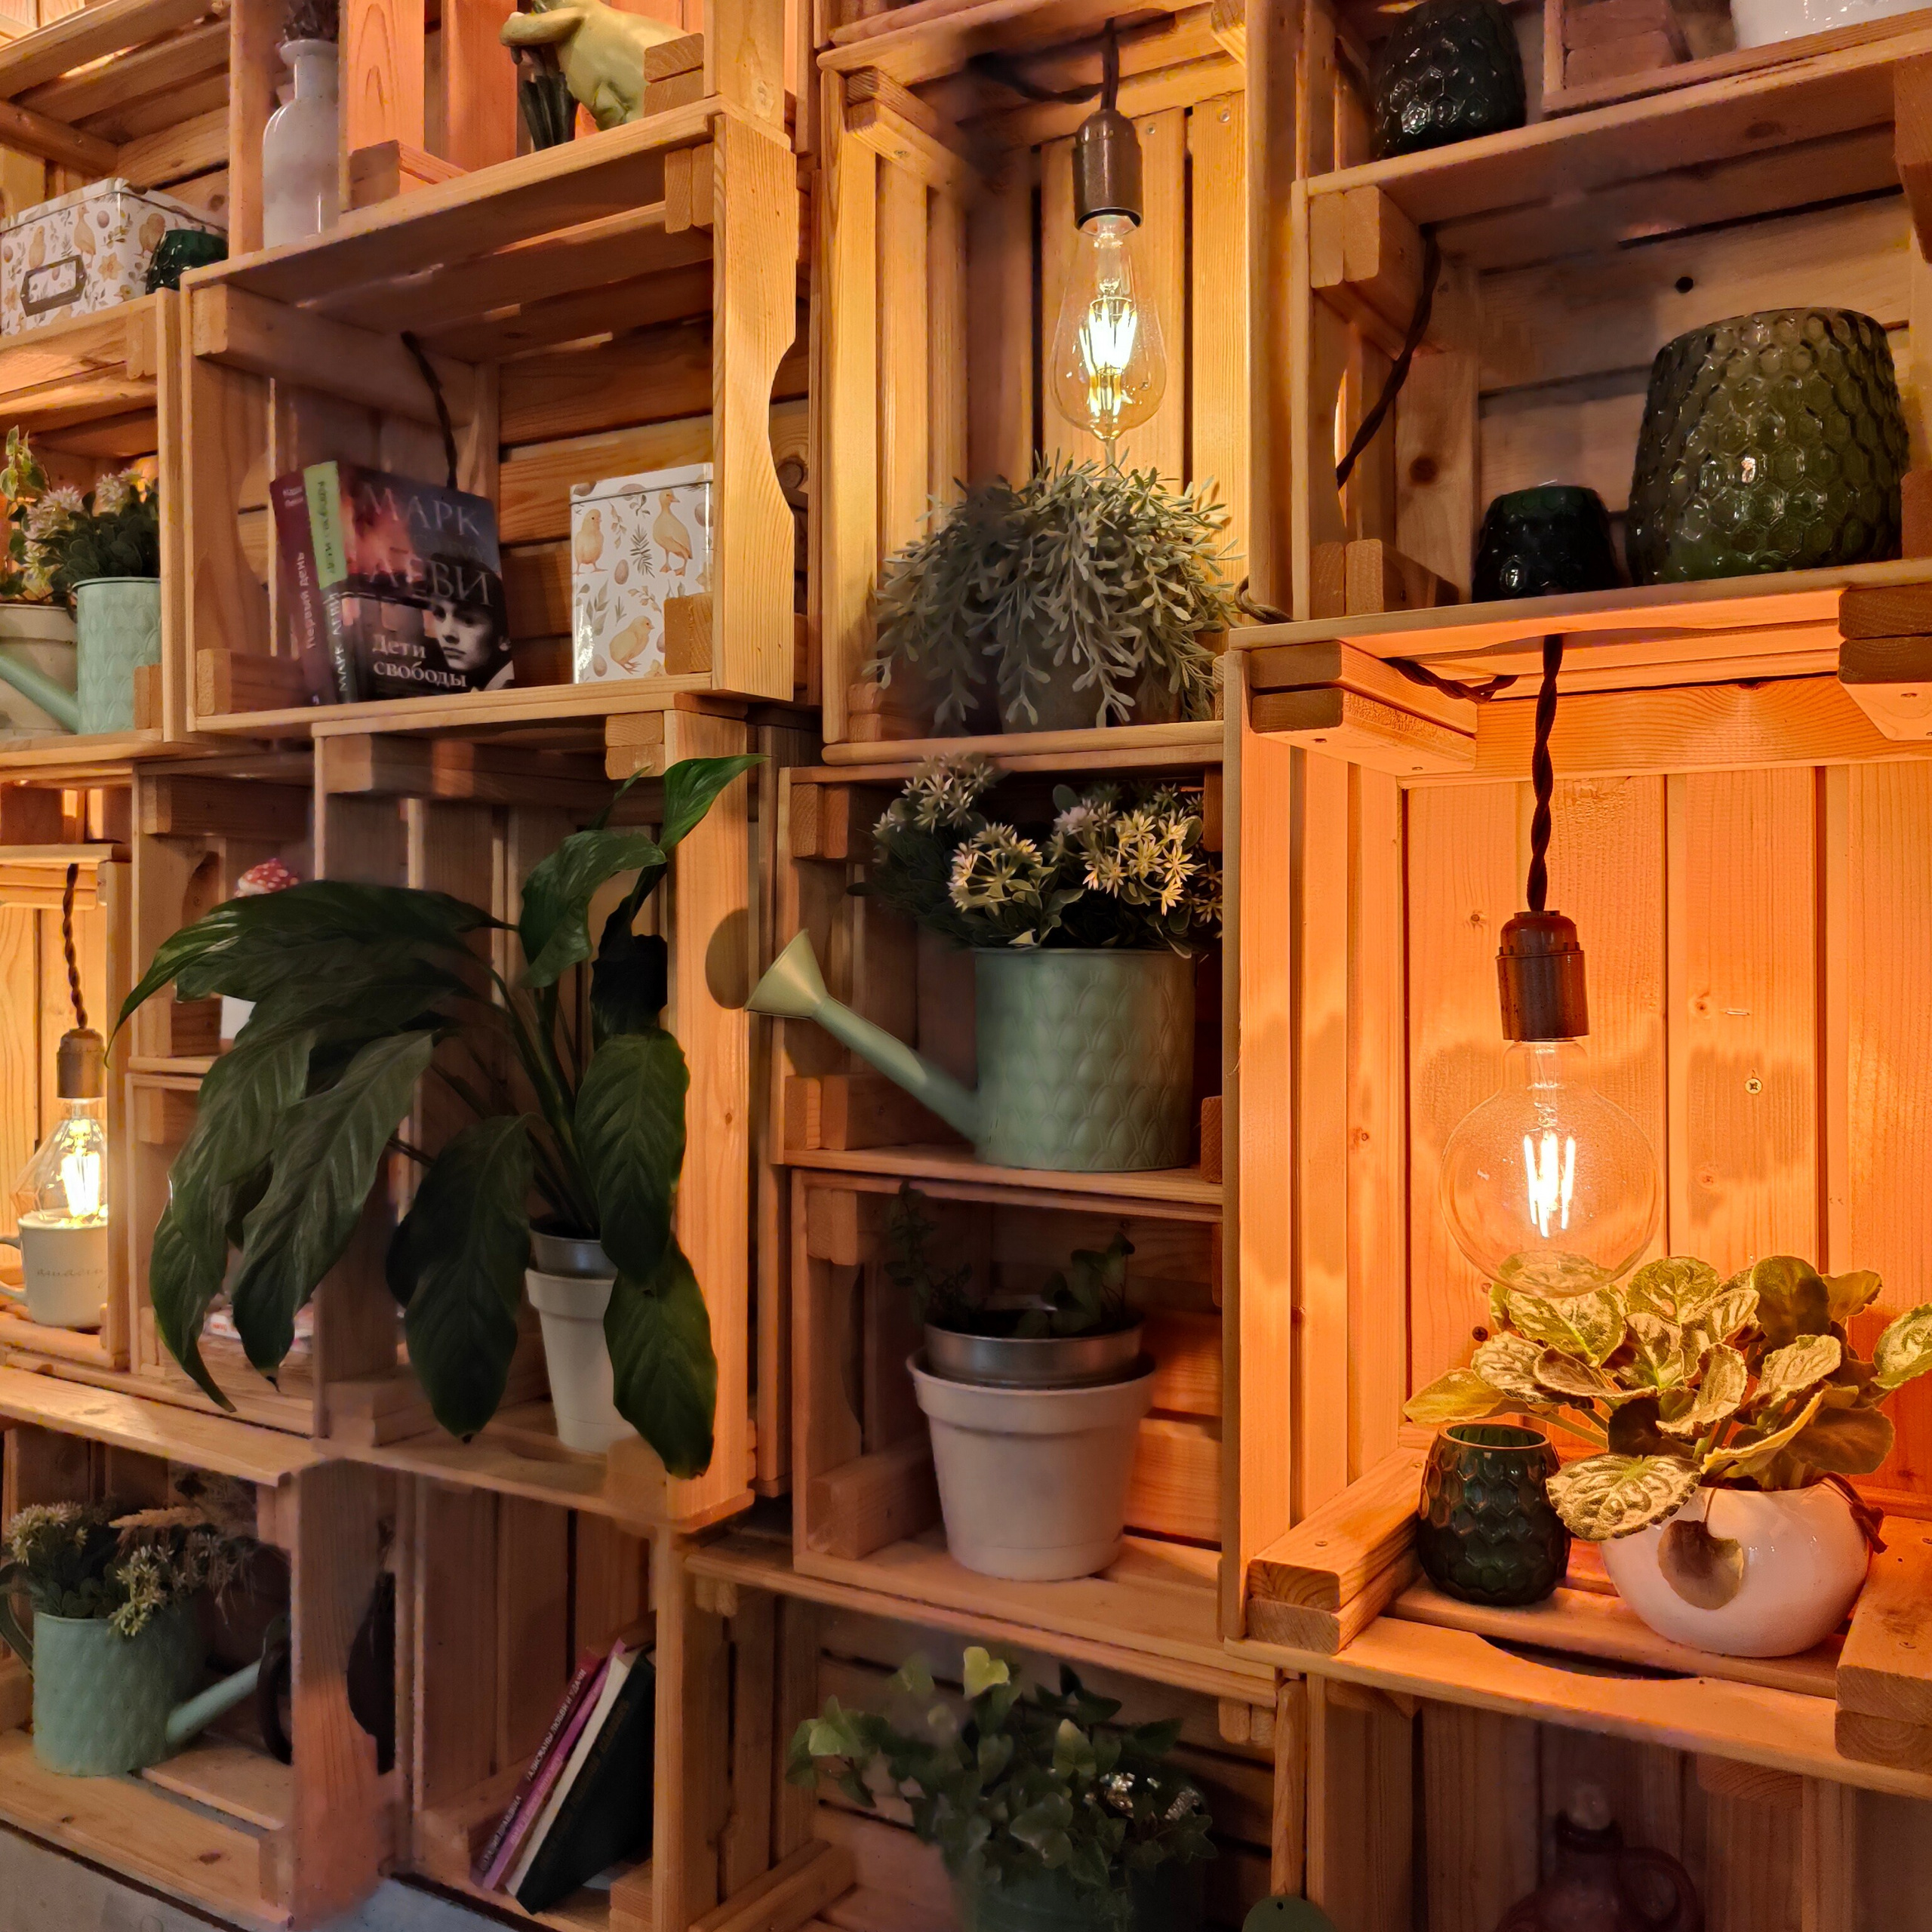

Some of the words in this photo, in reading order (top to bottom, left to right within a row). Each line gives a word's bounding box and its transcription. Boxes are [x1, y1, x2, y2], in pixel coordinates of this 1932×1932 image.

[361, 483, 481, 537] МАРК
[368, 552, 494, 608] ЛЕВИ
[335, 644, 348, 691] МАРК
[372, 635, 426, 658] Дети
[374, 661, 467, 688] свободы
